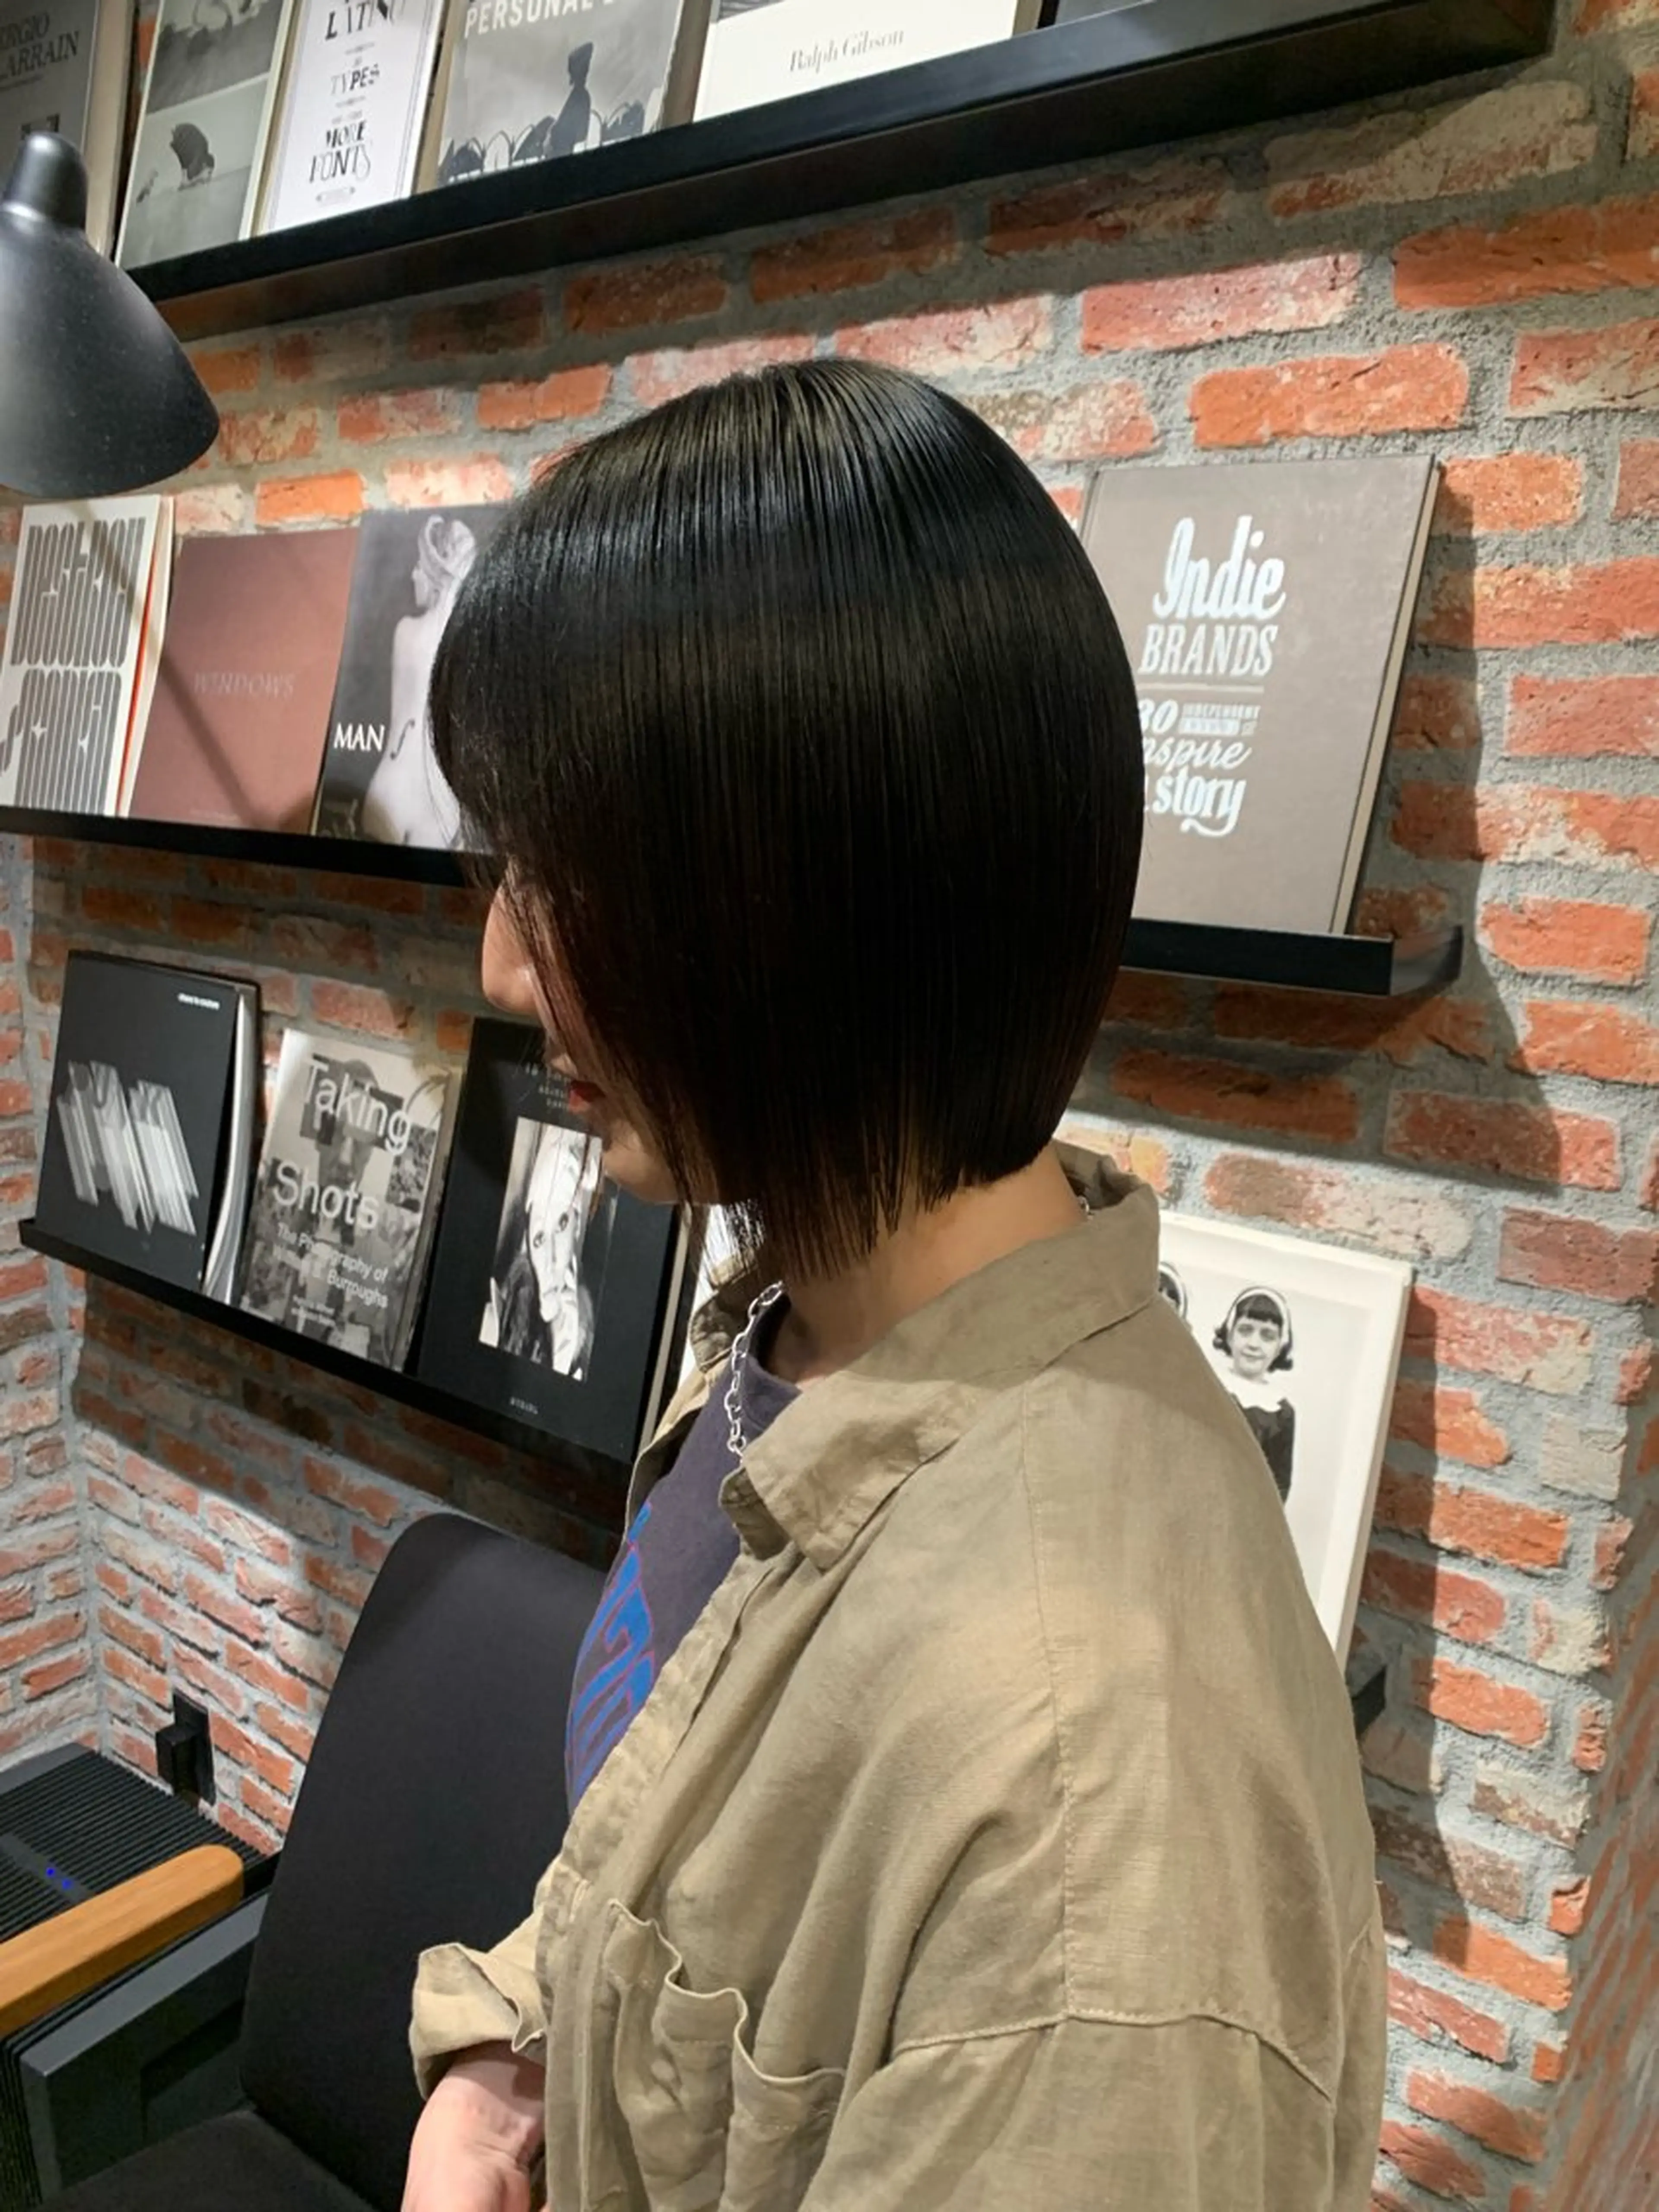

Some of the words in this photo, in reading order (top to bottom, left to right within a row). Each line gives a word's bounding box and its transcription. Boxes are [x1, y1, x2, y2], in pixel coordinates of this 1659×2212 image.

[0, 12, 50, 50] ERGIO
[790, 40, 838, 74] Ralph
[842, 30, 904, 57] Gibson
[325, 119, 366, 148] MORE
[309, 144, 371, 184] FONTS
[1152, 515, 1287, 621] Indie
[1137, 623, 1279, 677] BRANDS
[334, 722, 385, 753] MAN
[1142, 737, 1252, 774] nspire
[1152, 764, 1247, 837] story
[304, 1058, 411, 1156] Taking
[273, 1161, 379, 1229] Shots
[299, 1233, 372, 1280] Phgraphy
[374, 1266, 388, 1284] of
[327, 1268, 388, 1308] Burroughs
